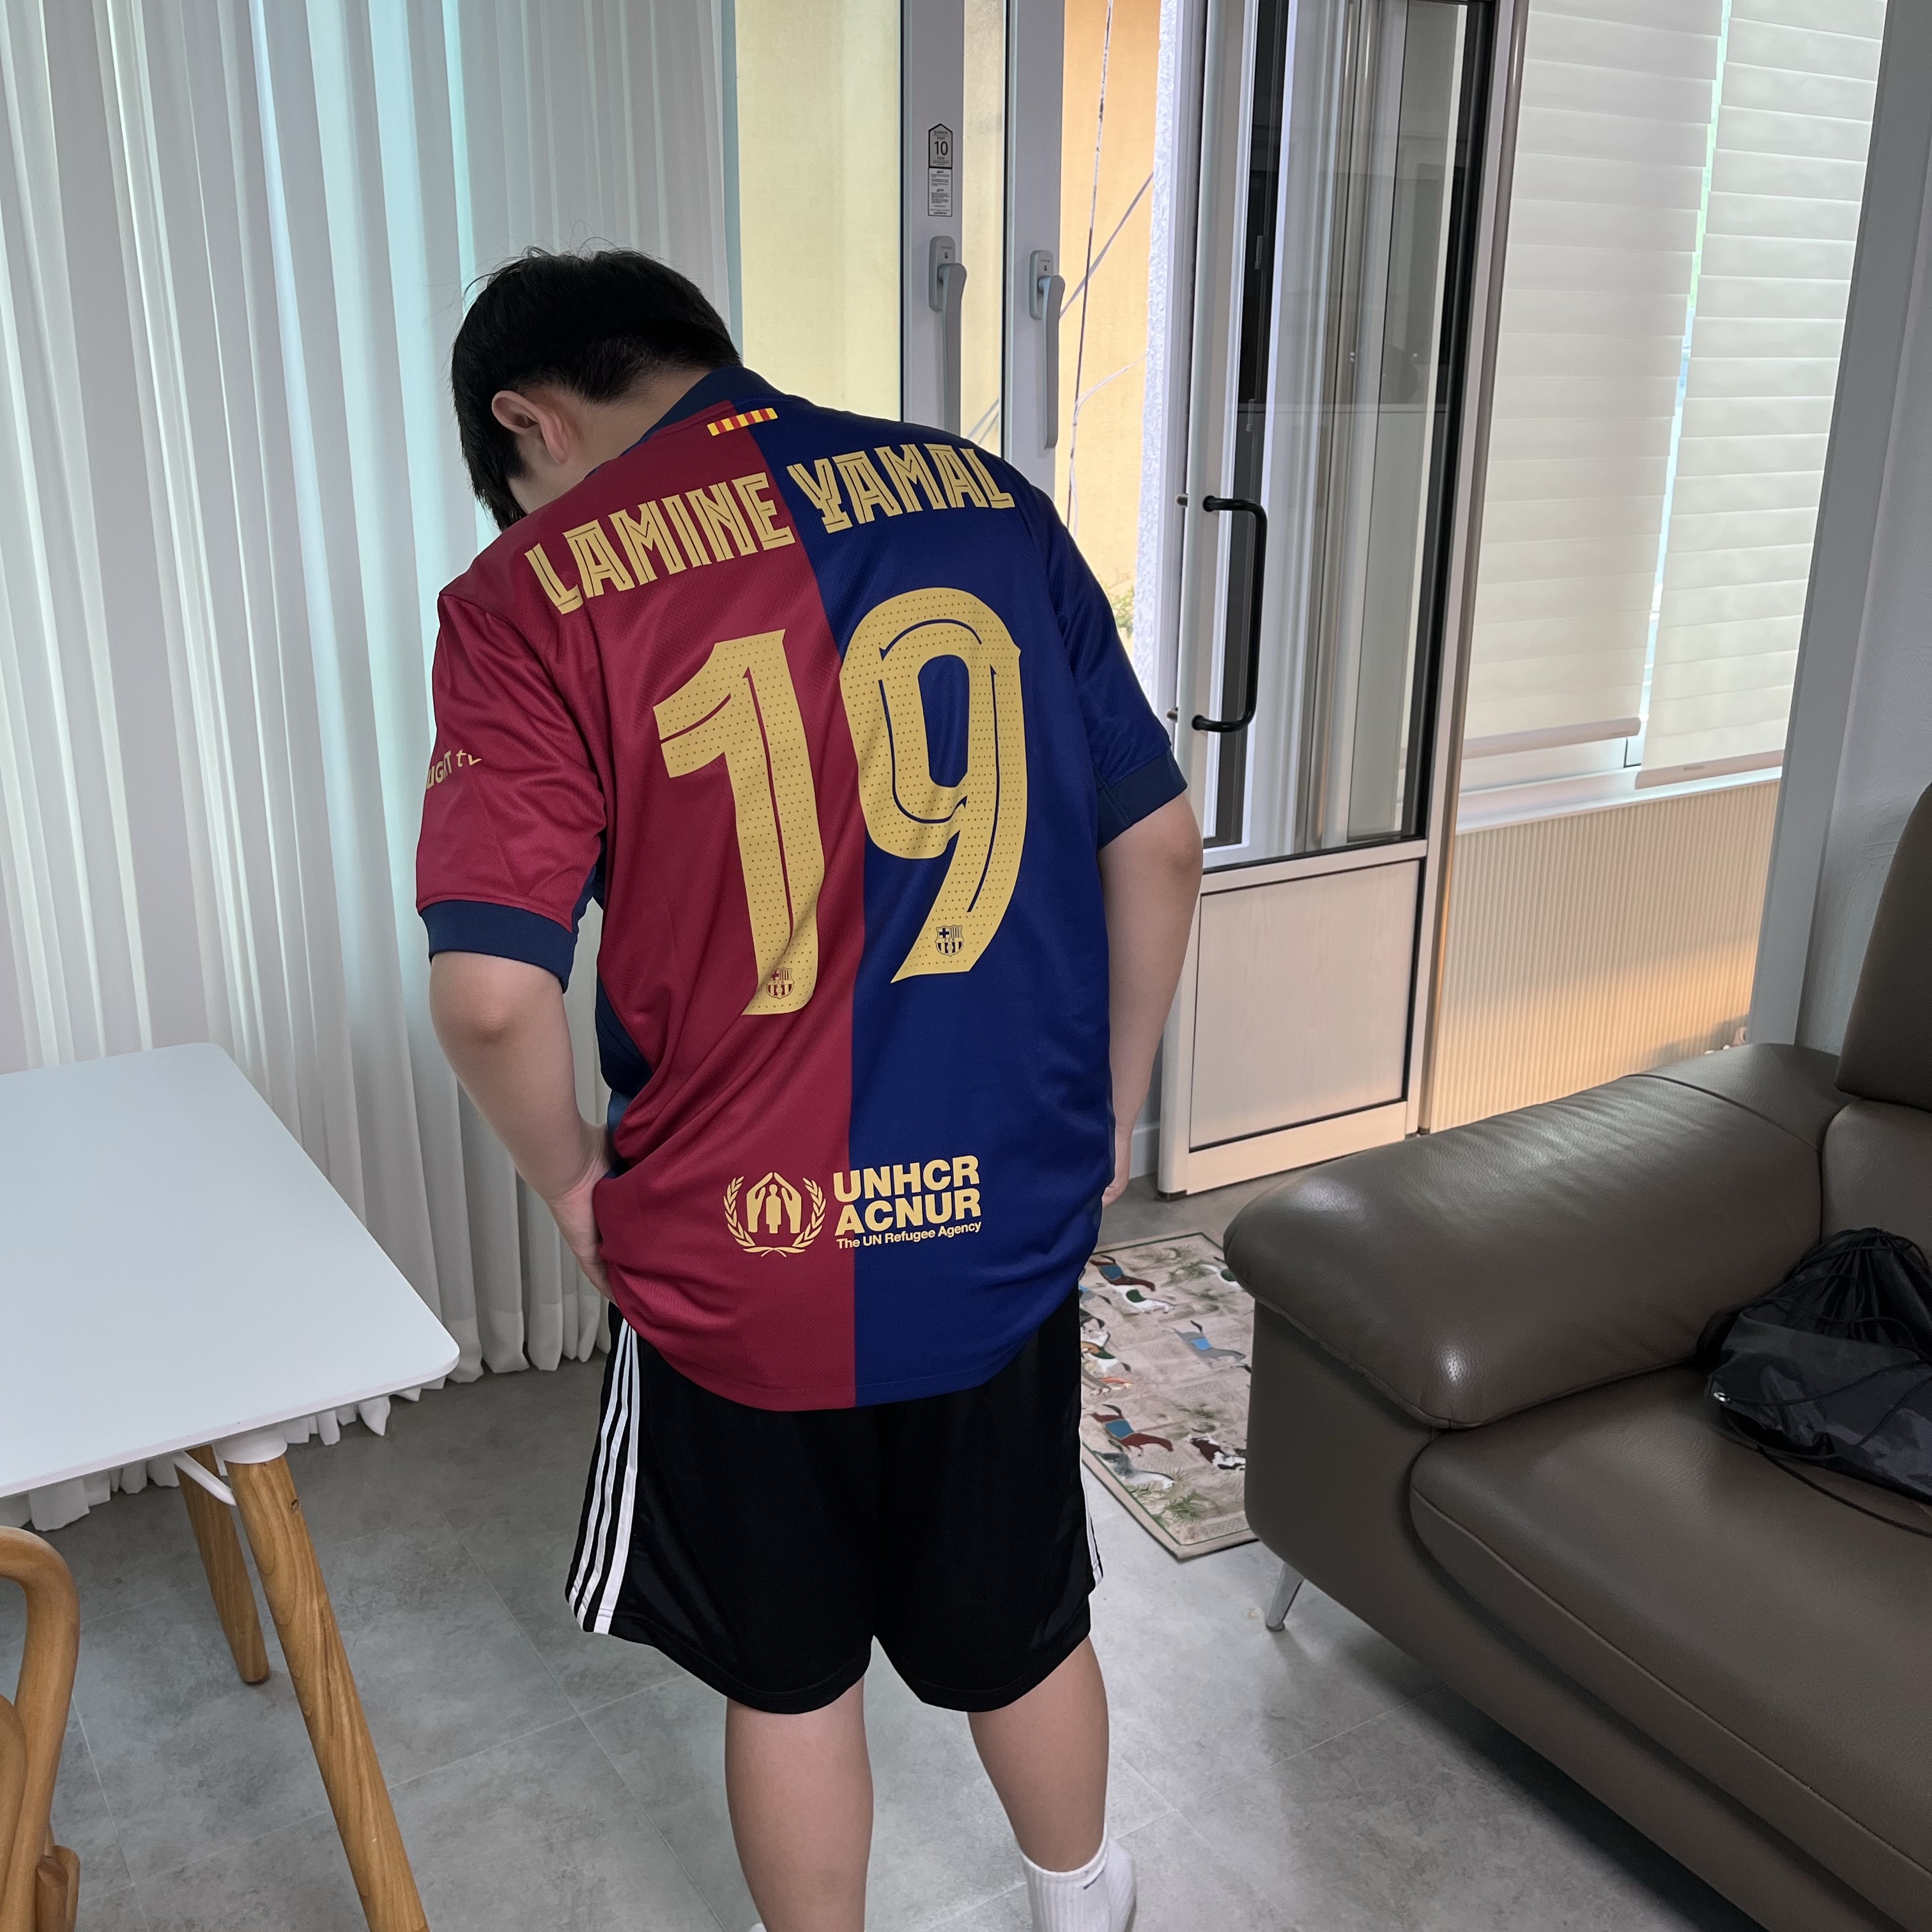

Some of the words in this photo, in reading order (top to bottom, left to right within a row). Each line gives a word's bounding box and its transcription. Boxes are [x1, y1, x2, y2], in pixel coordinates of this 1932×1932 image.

[934, 141, 948, 155] 10
[524, 471, 796, 615] LAMINE
[786, 442, 1015, 534] YAMAL
[456, 748, 482, 767] tv
[652, 586, 1027, 1016] 19
[833, 1155, 980, 1203] UNHCR
[834, 1188, 981, 1236] ACNUR
[836, 1238, 860, 1249] The
[862, 1234, 882, 1246] UN
[885, 1230, 935, 1243] Refugee
[938, 1222, 982, 1238] Agency
